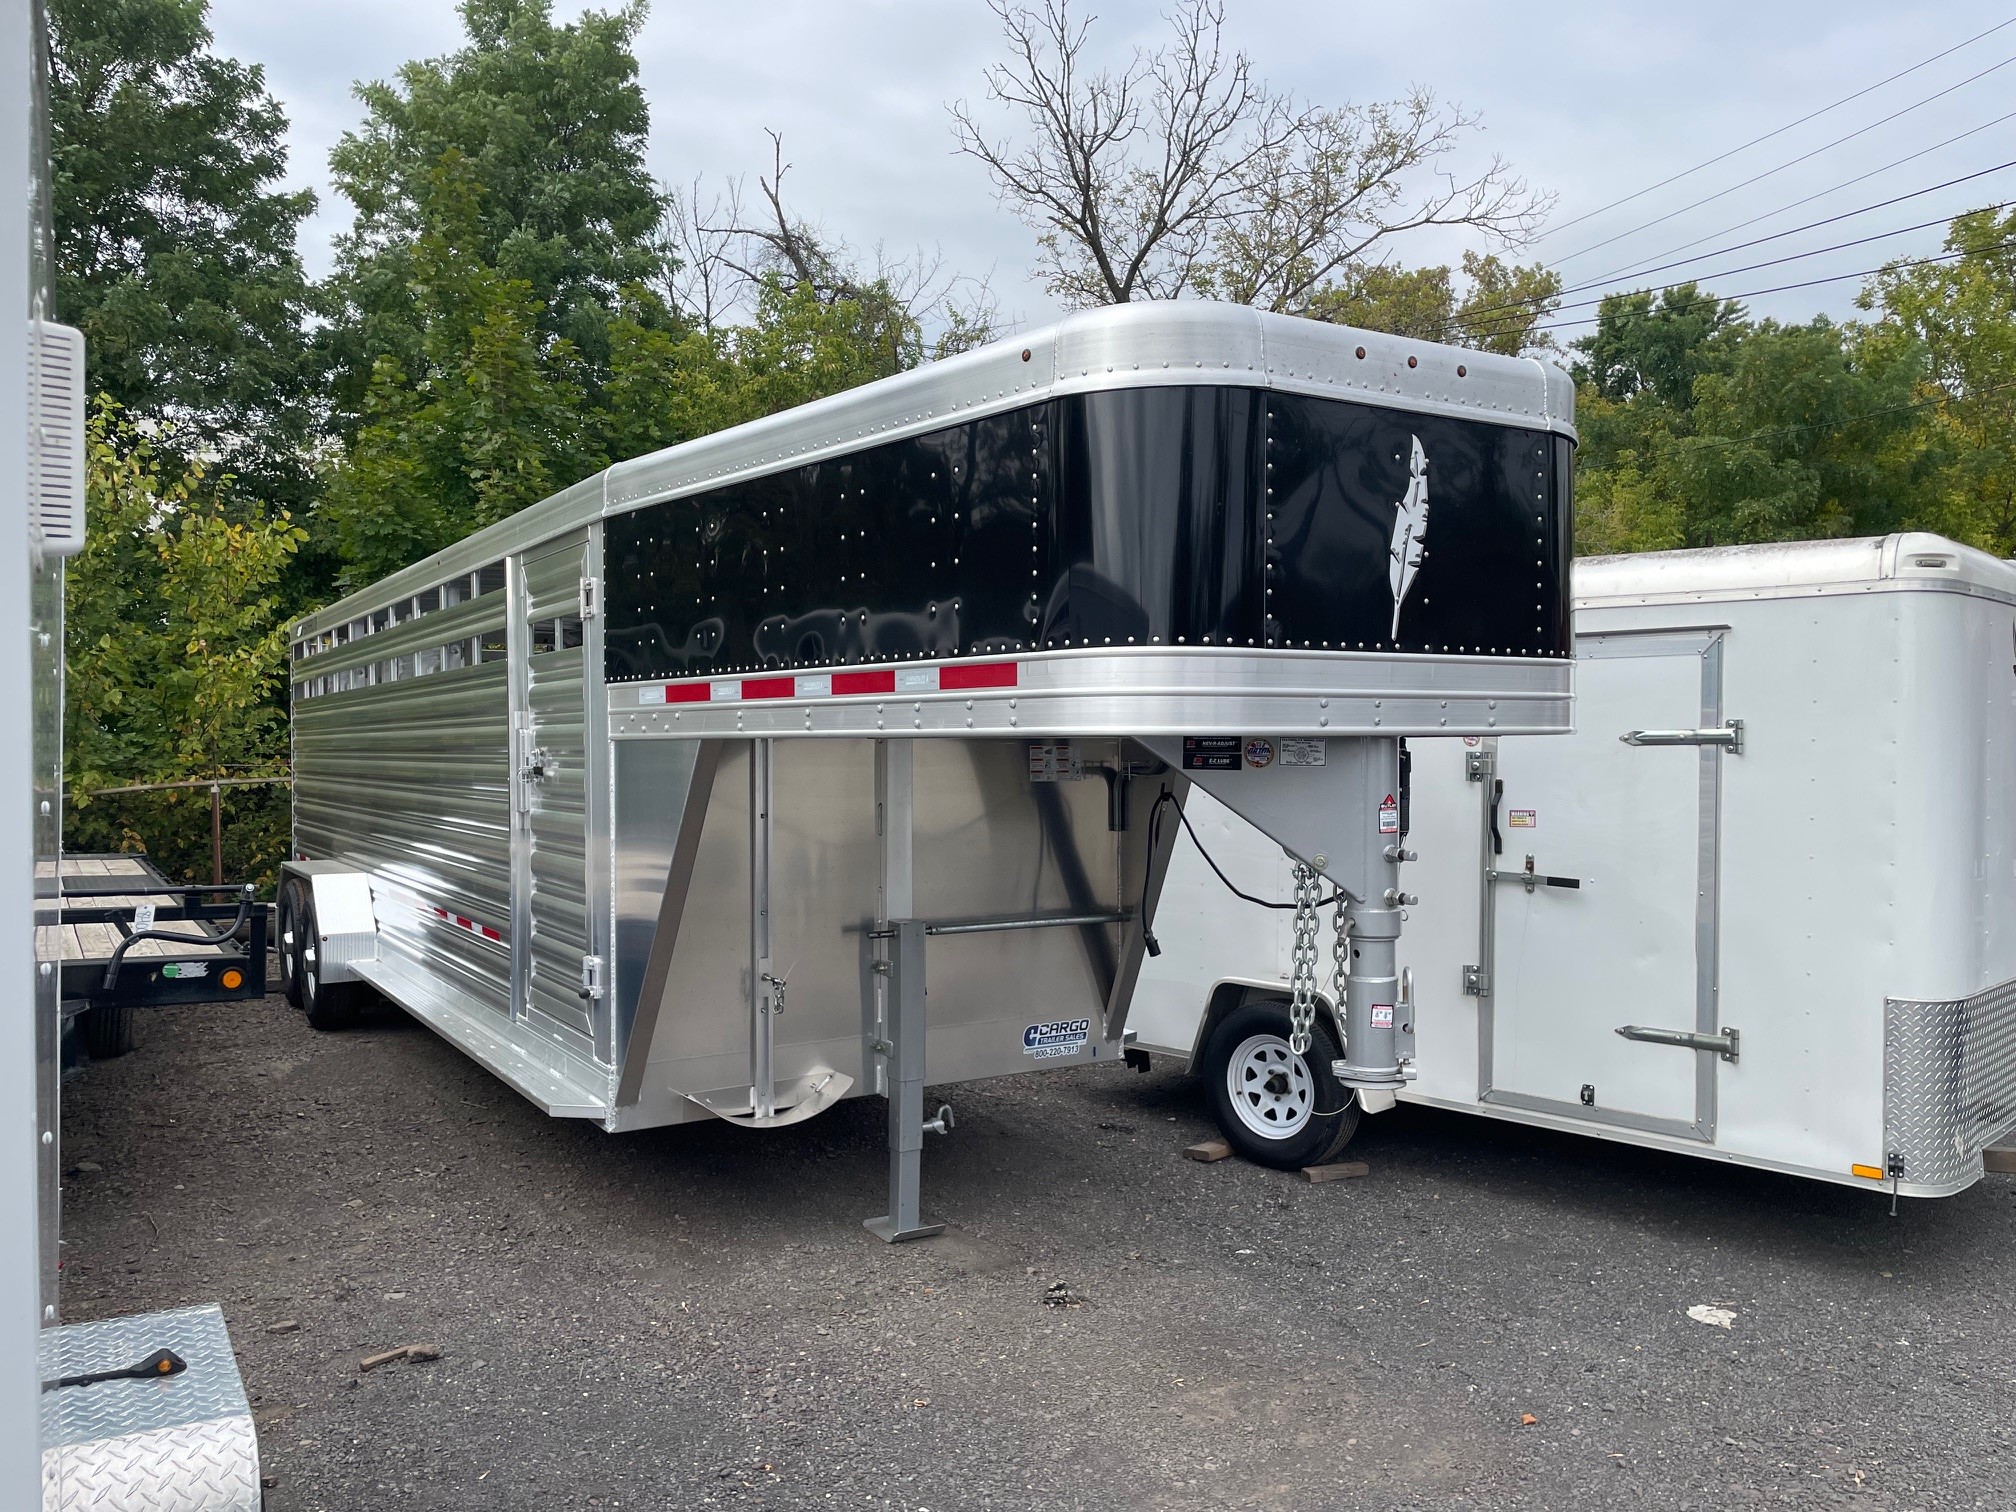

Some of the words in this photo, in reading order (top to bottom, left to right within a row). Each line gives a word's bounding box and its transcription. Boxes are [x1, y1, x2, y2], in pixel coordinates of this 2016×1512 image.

[1040, 1020, 1089, 1035] CARGO
[1040, 1035, 1064, 1044] TRAILER
[1065, 1033, 1084, 1041] SALES
[1035, 1045, 1079, 1058] 800-220-7913
